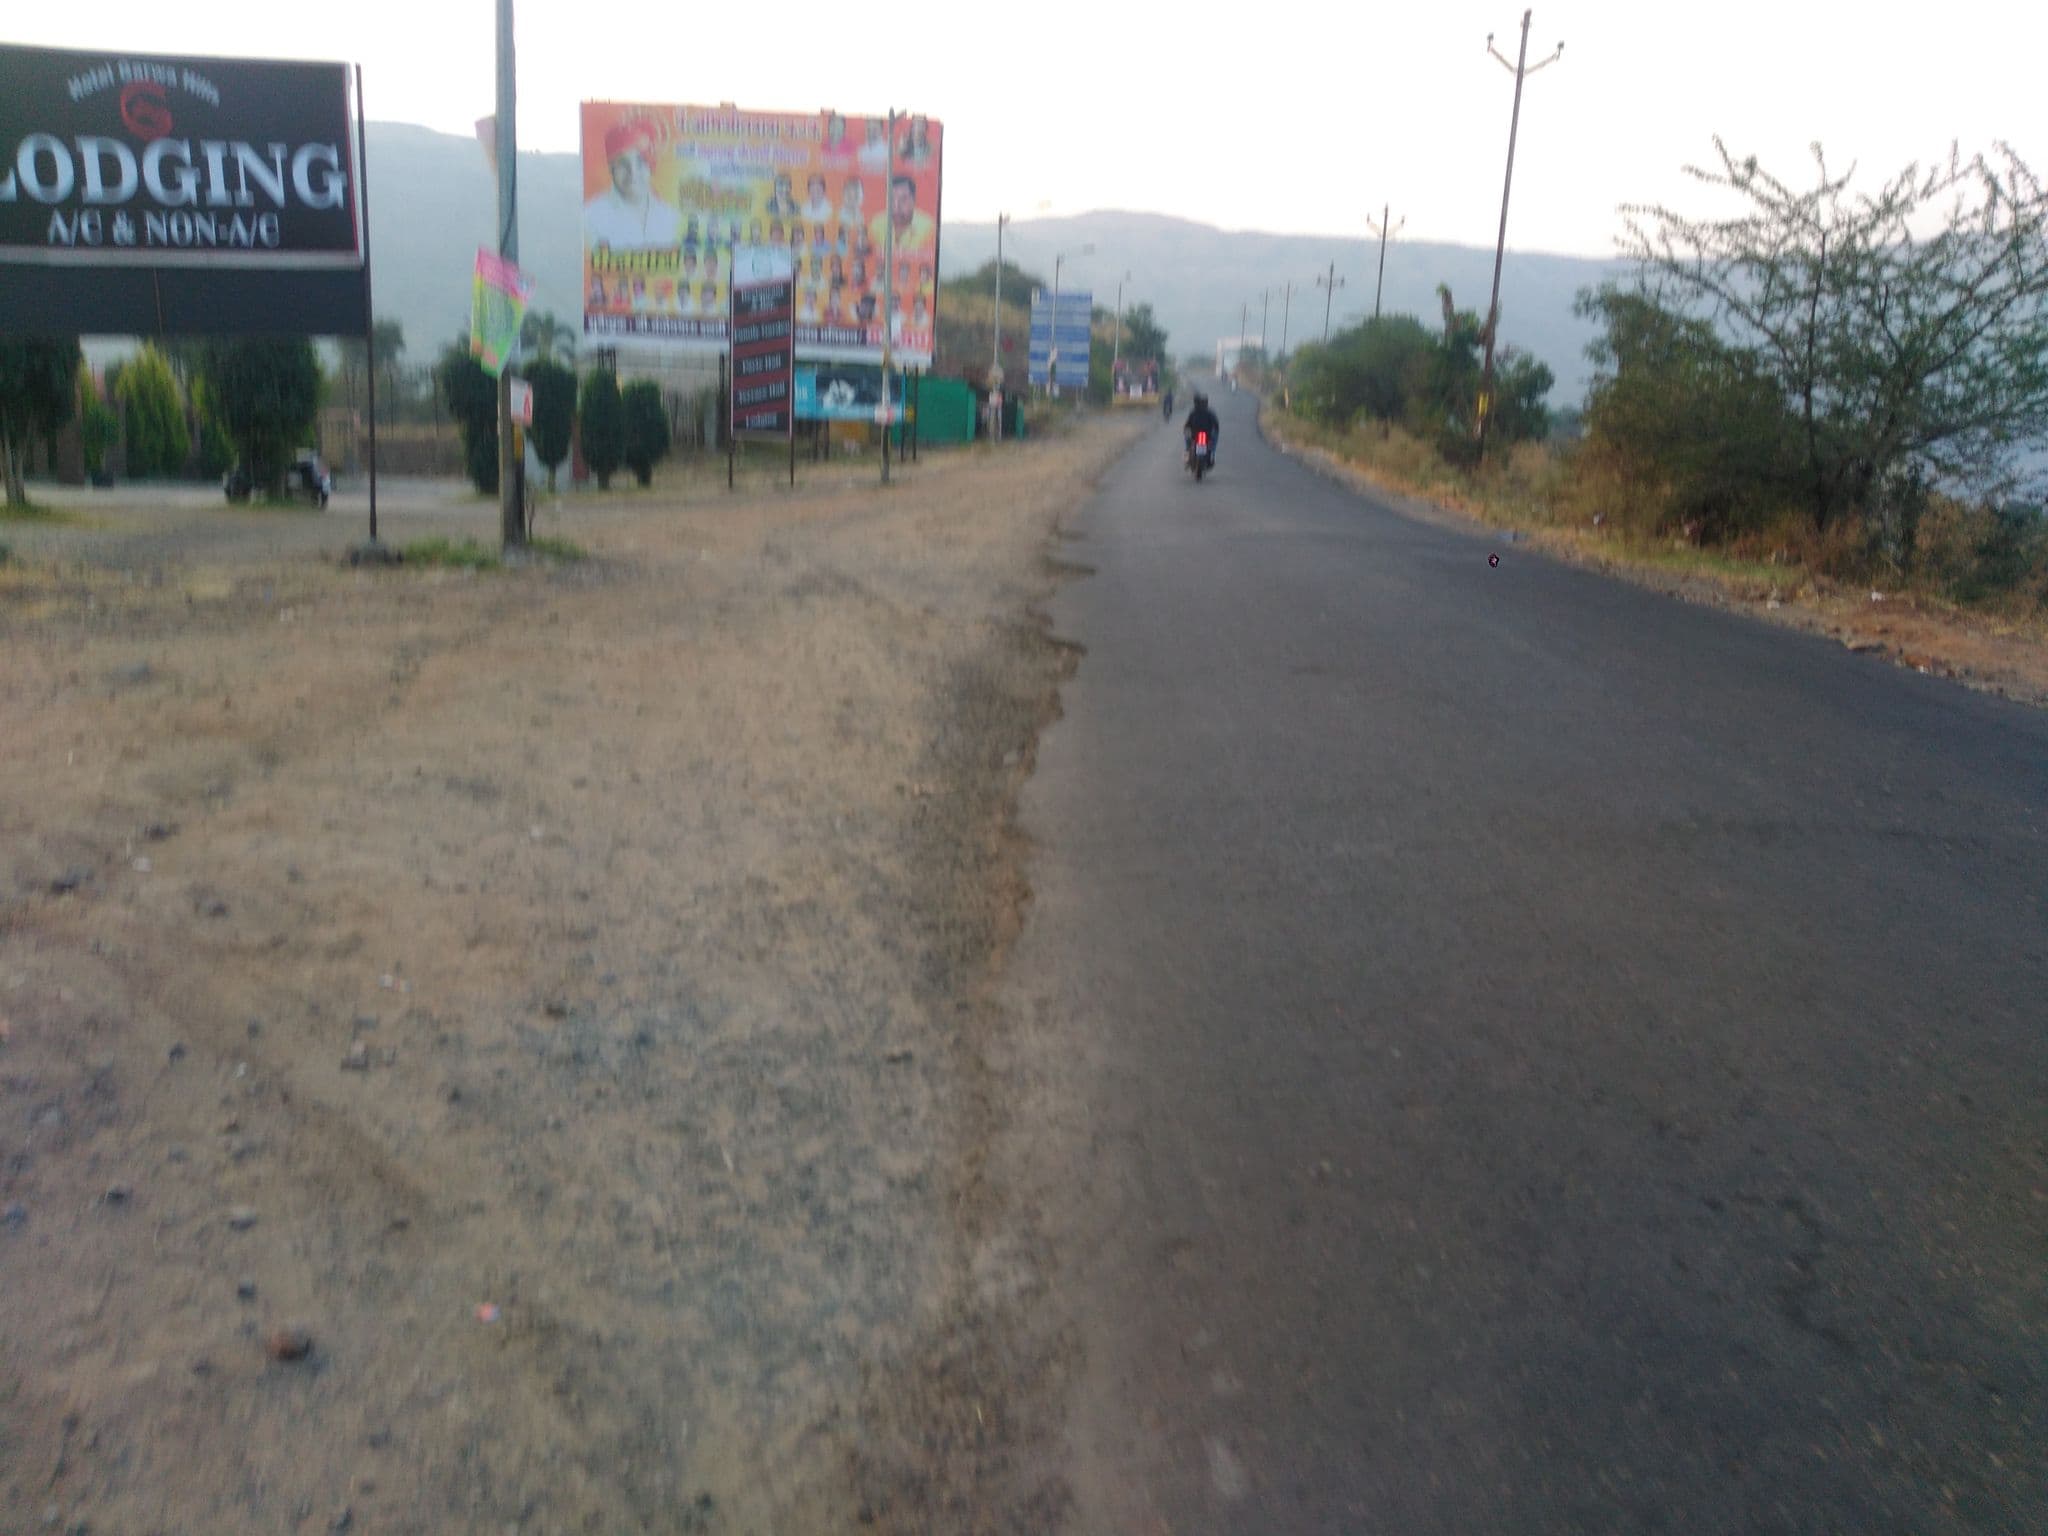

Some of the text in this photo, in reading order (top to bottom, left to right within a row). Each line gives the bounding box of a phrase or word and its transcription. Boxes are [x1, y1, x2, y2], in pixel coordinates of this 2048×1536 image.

[48, 208, 281, 248] A/C & NON-A/C
